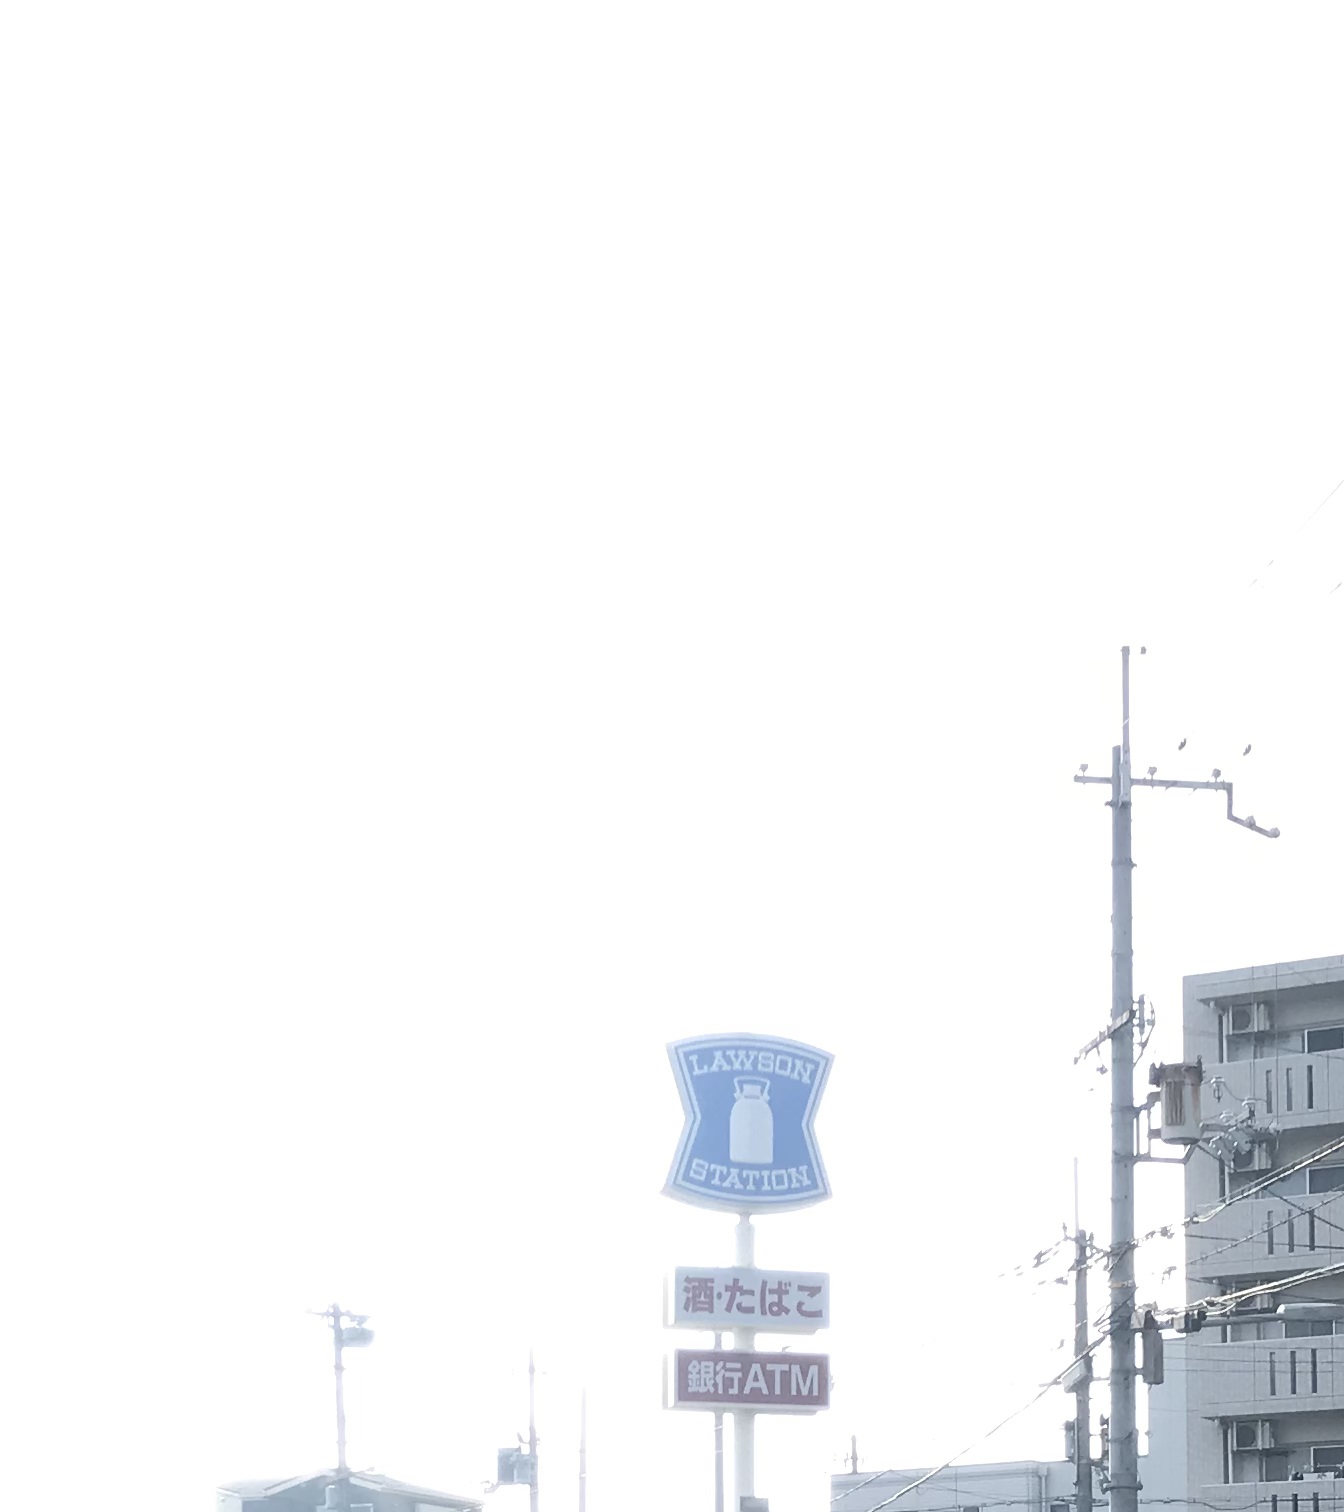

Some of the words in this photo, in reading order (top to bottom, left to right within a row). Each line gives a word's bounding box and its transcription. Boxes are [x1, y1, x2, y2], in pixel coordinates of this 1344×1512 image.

[692, 1049, 817, 1084] LAWSON
[688, 1158, 812, 1192] STATION
[687, 1360, 820, 1397] 銀行ATM
